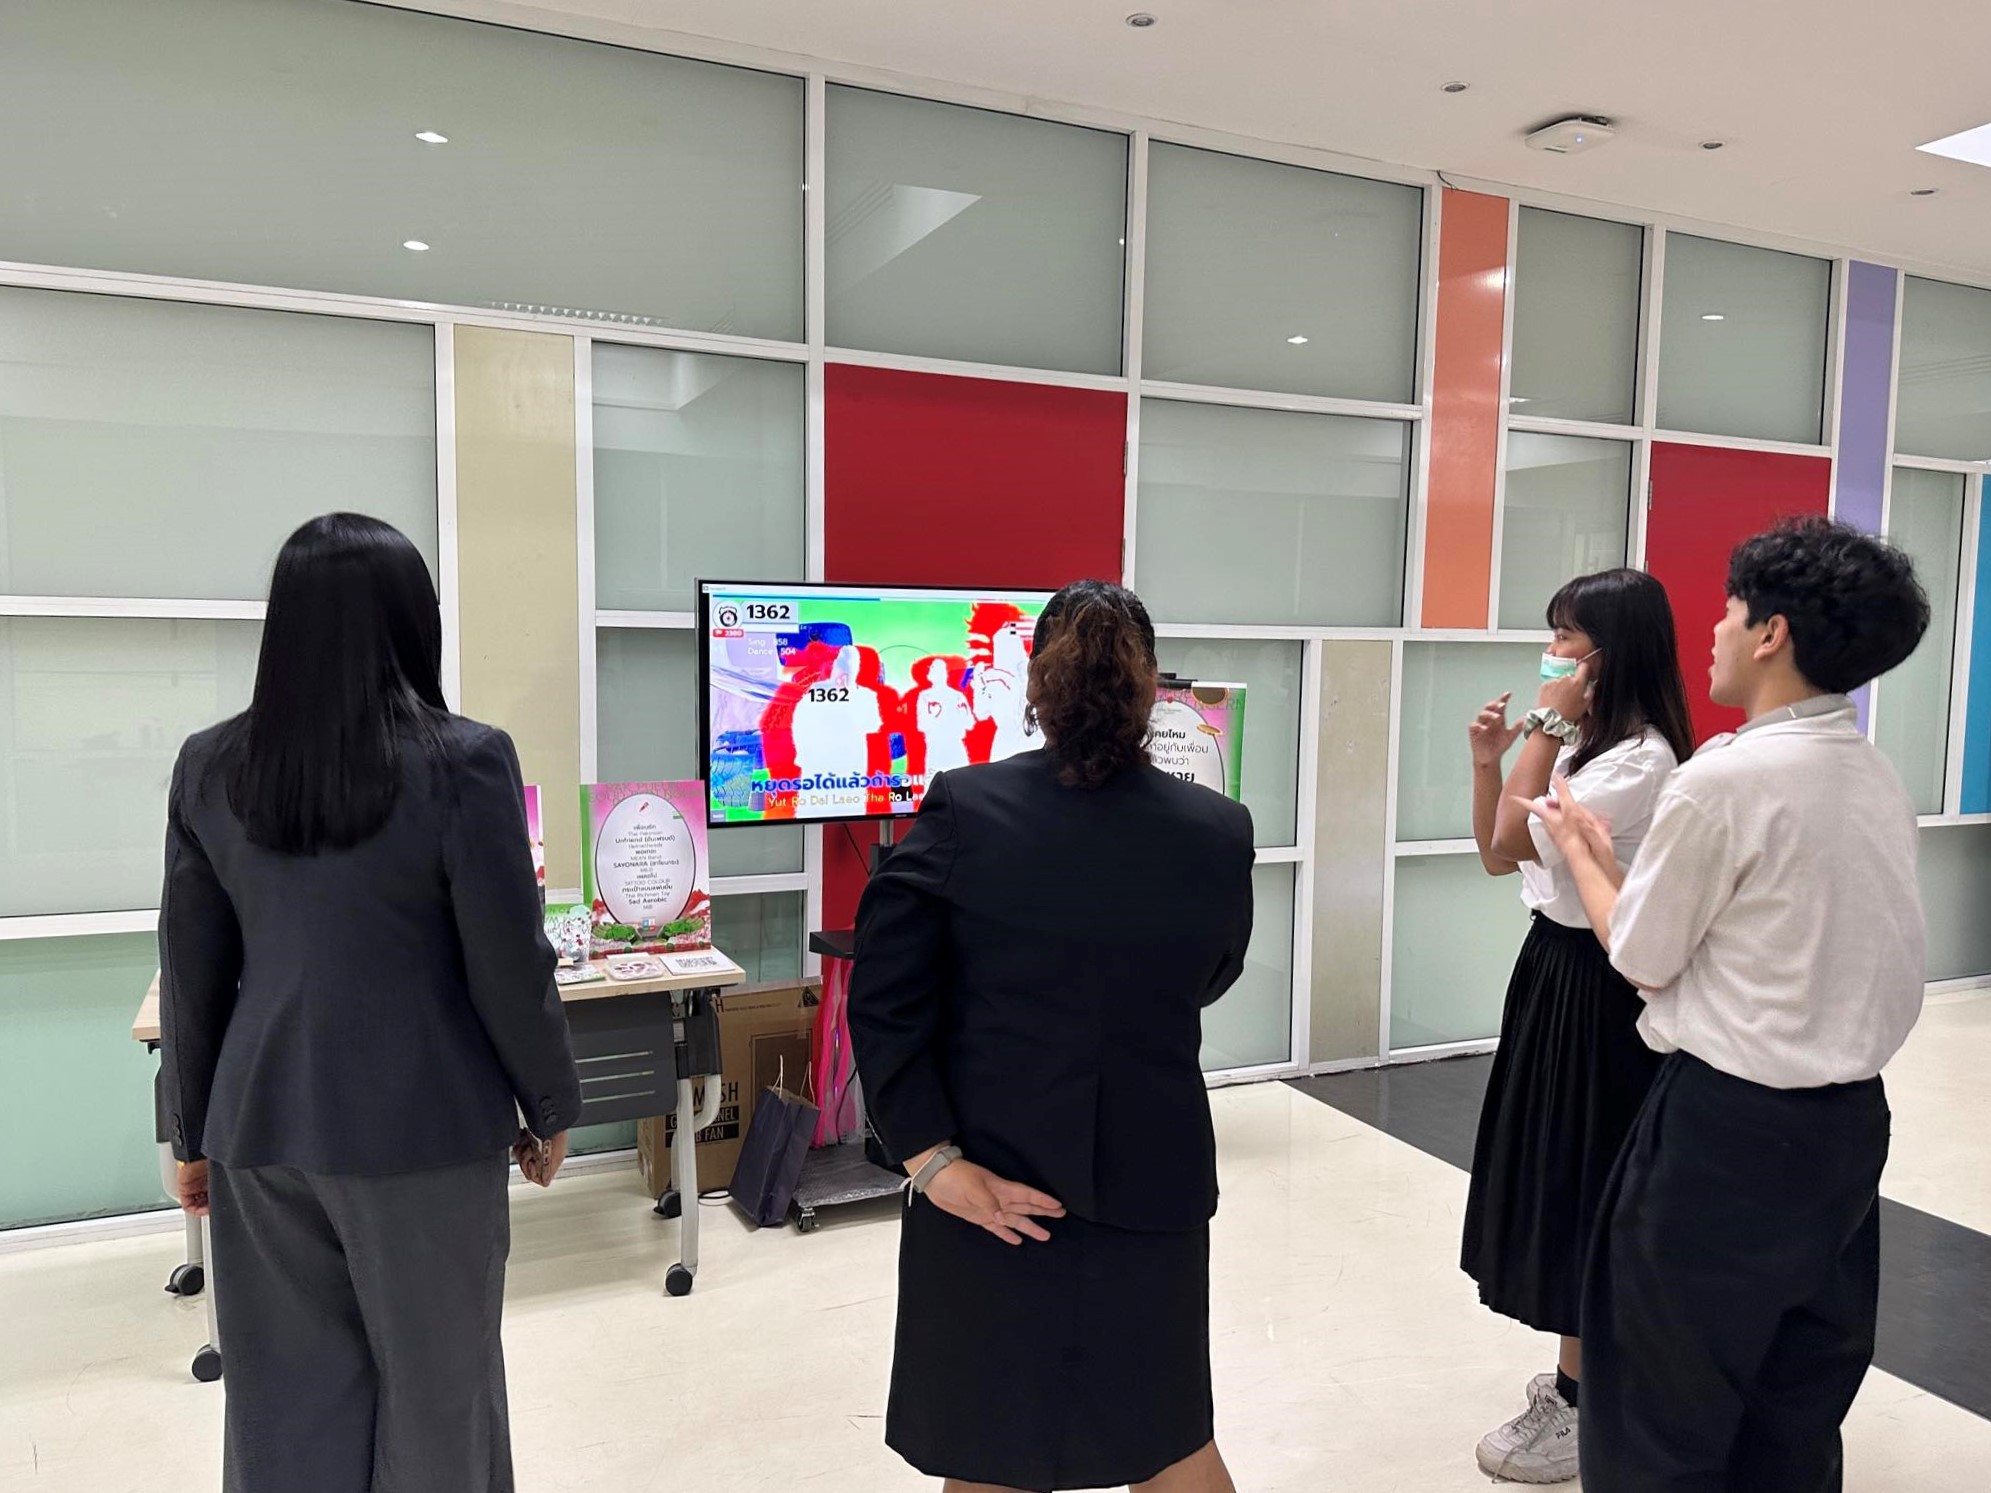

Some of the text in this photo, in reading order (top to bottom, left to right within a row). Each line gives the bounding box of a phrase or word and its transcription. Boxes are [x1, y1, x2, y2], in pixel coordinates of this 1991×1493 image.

[746, 604, 790, 619] 1362
[780, 648, 796, 656] 504
[808, 688, 849, 703] 1362
[768, 796, 787, 807] Yut
[791, 796, 806, 807] Ro
[889, 790, 903, 802] Ro
[642, 897, 667, 905] Aerobic
[704, 1127, 724, 1141] FAN
[1556, 1427, 1571, 1439] FILA
